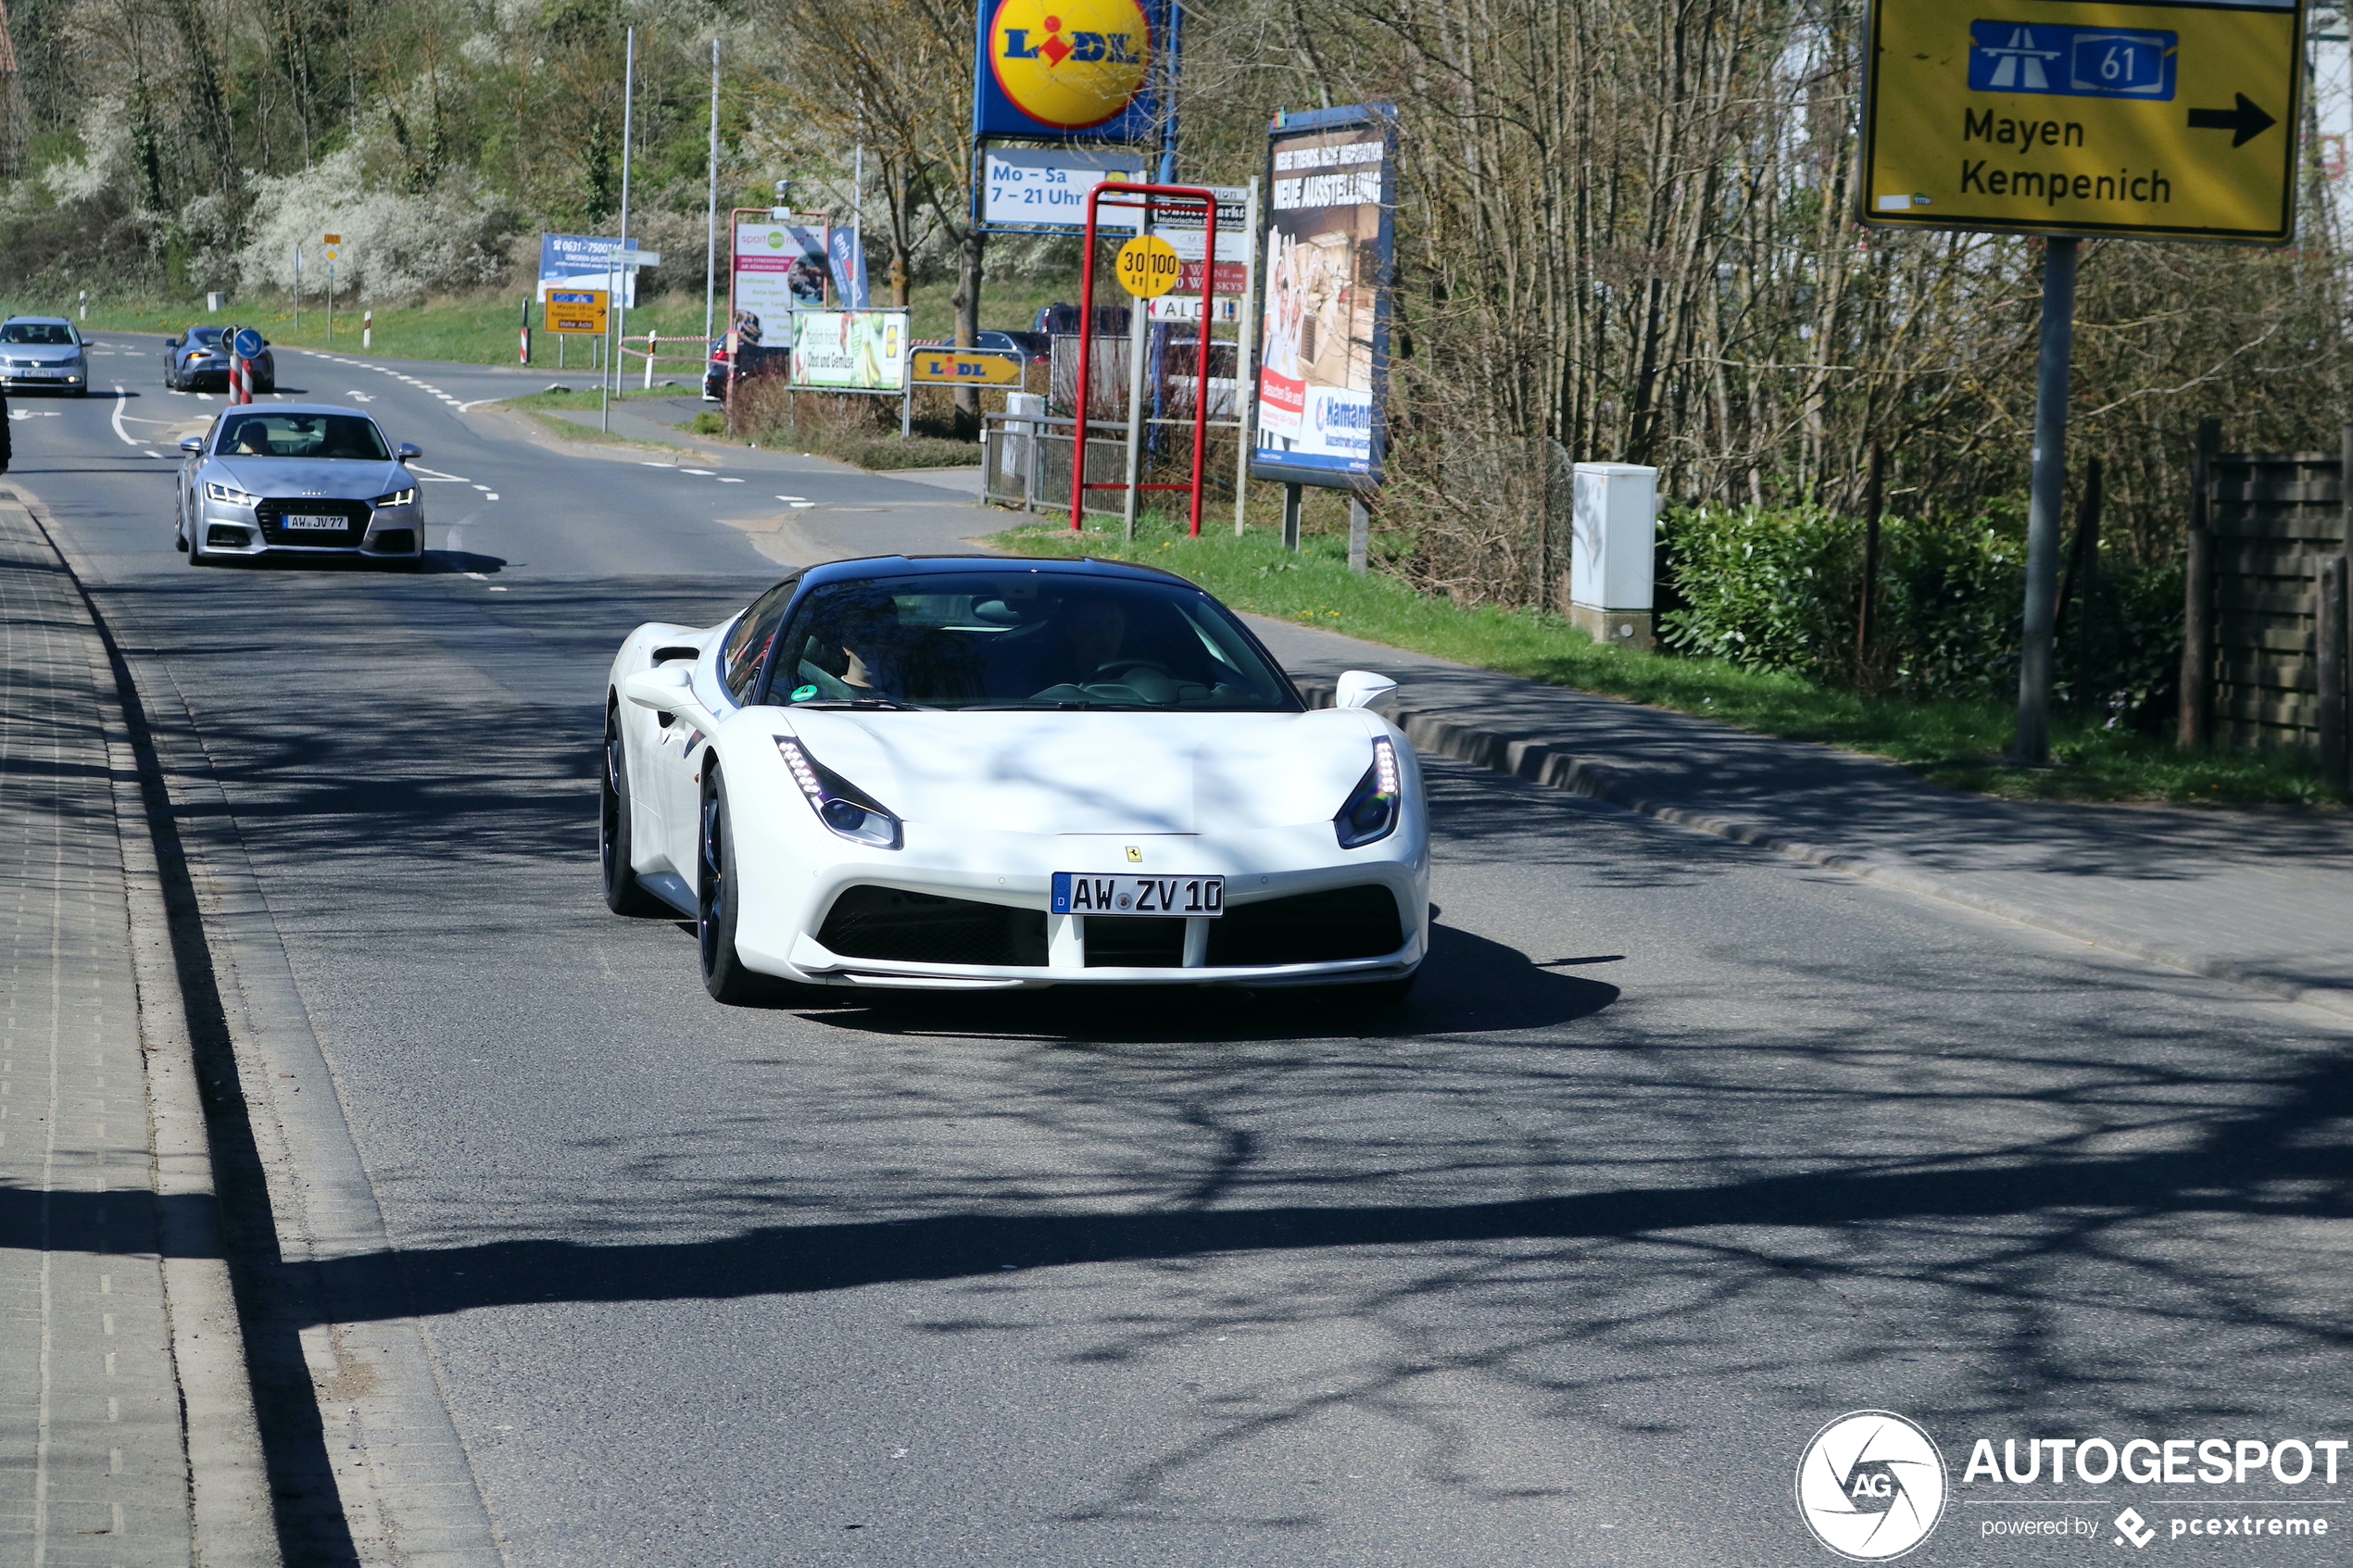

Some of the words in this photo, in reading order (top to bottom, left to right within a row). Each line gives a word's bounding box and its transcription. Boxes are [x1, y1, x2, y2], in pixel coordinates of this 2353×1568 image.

[2100, 45, 2134, 82] 61
[1964, 107, 2084, 155] Mayen
[1276, 151, 1292, 170] NEUE
[992, 165, 1023, 182] Mo
[1045, 167, 1067, 183] Sa
[1961, 159, 2171, 207] Kempenich
[992, 187, 1001, 203] 7
[1024, 189, 1043, 205] 21
[1049, 189, 1084, 207] Uhr
[1274, 179, 1302, 209] NEUE
[1302, 170, 1382, 207] AUSSTELLUNG
[562, 240, 582, 253] 0631
[741, 234, 766, 245] sport
[768, 235, 785, 244] am
[786, 233, 805, 246] ring
[1124, 251, 1145, 272] 30
[1151, 253, 1176, 275] 100
[807, 351, 820, 369] Obst
[820, 353, 830, 368] und
[831, 352, 854, 370] Gemüse
[292, 517, 306, 528] AW
[313, 517, 328, 528] JV
[330, 518, 344, 528] 77
[1057, 897, 1065, 907] D
[1072, 878, 1115, 910] AW
[1135, 880, 1177, 911] ZV
[1184, 881, 1222, 911] 10
